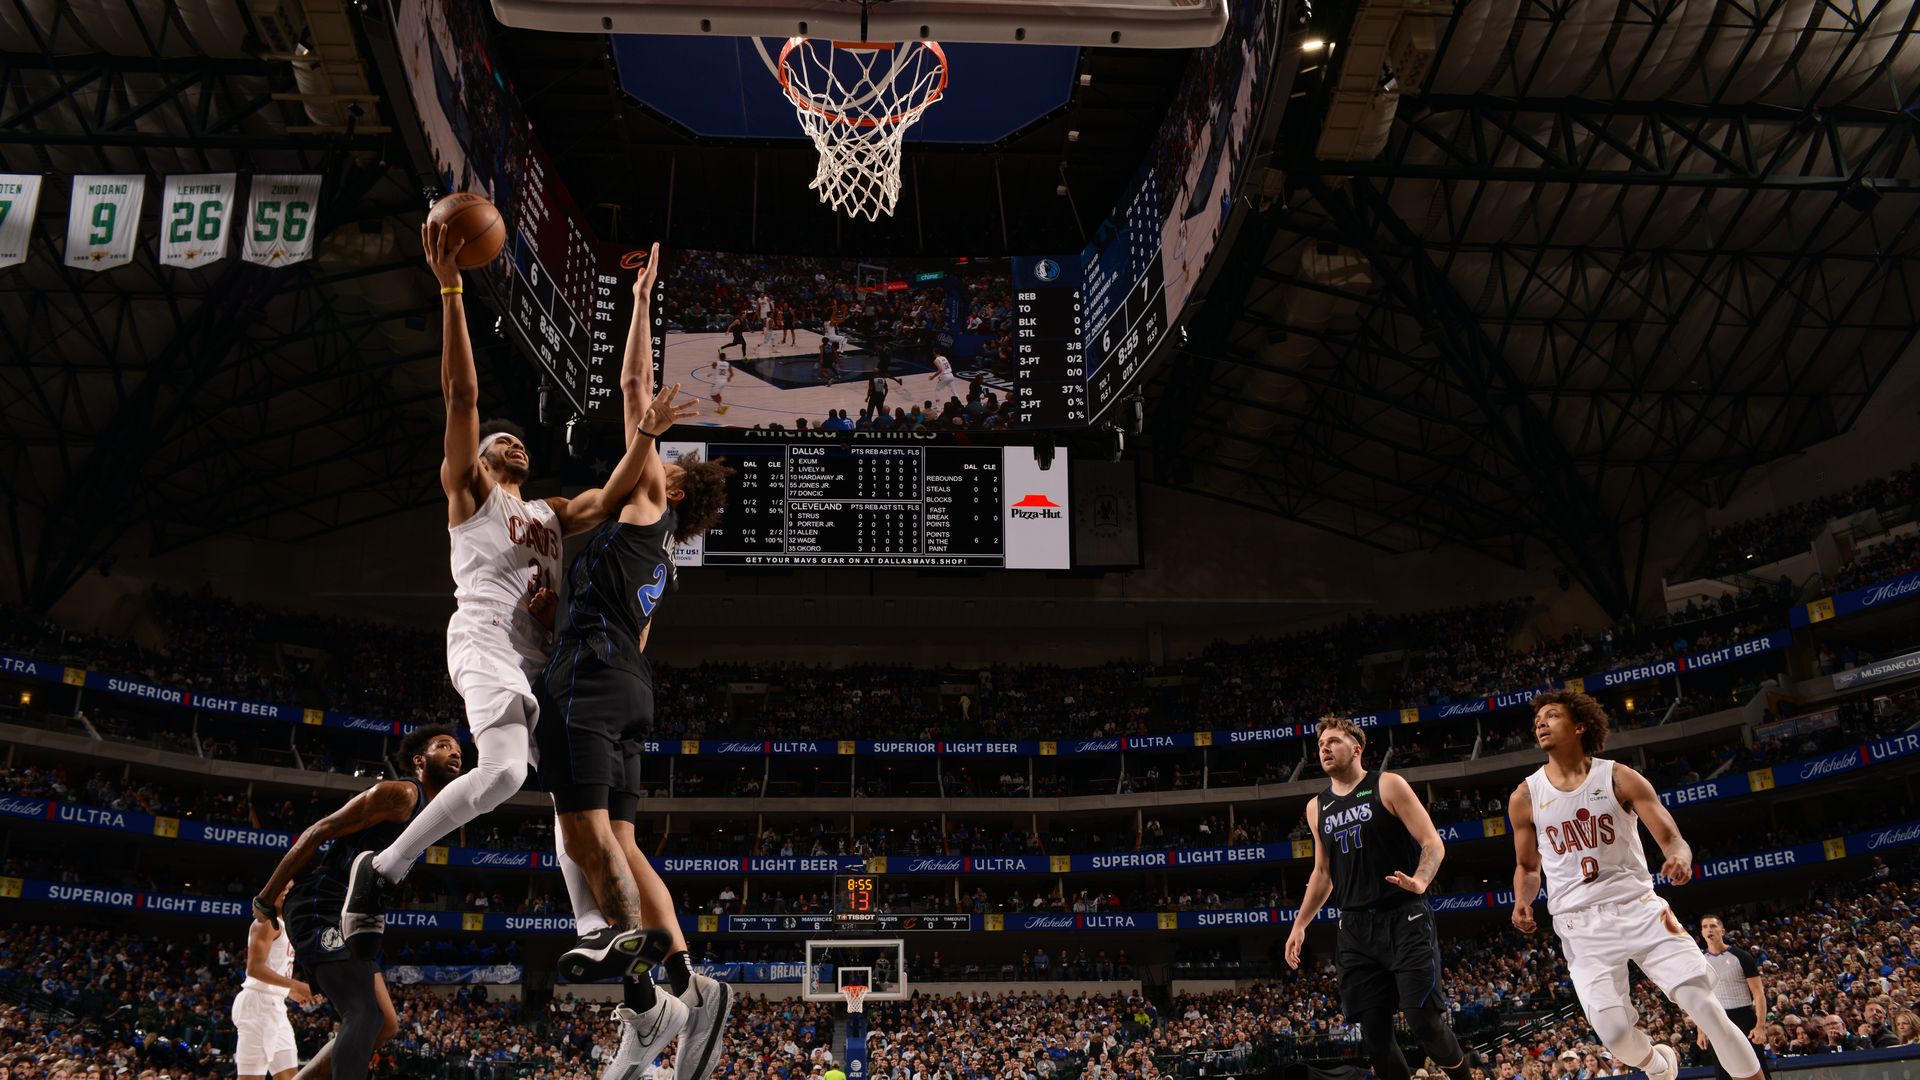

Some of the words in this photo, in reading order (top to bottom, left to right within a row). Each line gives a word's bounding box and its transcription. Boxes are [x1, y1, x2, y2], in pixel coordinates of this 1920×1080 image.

[88, 184, 127, 194] MODANO
[178, 184, 221, 195] LEHTINEN
[90, 202, 116, 246] 9
[170, 201, 222, 242] 26
[254, 202, 309, 242] 56
[531, 262, 538, 286] 6
[598, 275, 617, 285] REB
[597, 287, 611, 296] TO
[1139, 274, 1148, 302] 7
[1018, 292, 1036, 301] REB
[596, 300, 615, 310] BLK
[1018, 305, 1031, 313] TO
[595, 312, 612, 322] STL
[1018, 318, 1037, 326] BLK
[569, 313, 578, 338] 7
[539, 312, 563, 355] 8:55
[594, 331, 607, 340] FG
[1019, 329, 1035, 338] STL
[592, 343, 614, 353] 3-PT
[1019, 345, 1032, 353] FG
[1066, 342, 1082, 351] 3/8
[1103, 330, 1111, 352] 6
[1116, 327, 1139, 368] 8:55
[591, 356, 604, 365] FT
[1020, 356, 1040, 365] 3-PT
[1067, 354, 1083, 363] 0/2
[590, 374, 603, 384] FG
[1019, 370, 1031, 378] FT
[1067, 368, 1083, 377] 0/0
[589, 387, 612, 397] 3-PT
[1020, 387, 1033, 396] FG
[1062, 385, 1074, 394] 37
[588, 400, 601, 409] FT
[1020, 400, 1041, 409] 3-PT
[1021, 414, 1032, 422] FT
[792, 447, 825, 456] DALLAS
[509, 516, 558, 560] CAVS
[637, 563, 667, 616] 2
[1862, 576, 1920, 606] Michelo
[0, 656, 37, 676] TRA
[1604, 659, 1676, 686] SUPERIOR
[1688, 648, 1730, 670] LIGHT
[1734, 638, 1770, 657] BEER
[1861, 662, 1906, 678] MUSTANG
[108, 679, 181, 703] SUPERIOR
[193, 695, 238, 711] LIGHT
[241, 702, 278, 717] BEER
[1438, 700, 1485, 718] Michelob
[343, 717, 391, 731] Michelob
[1230, 727, 1293, 742] SUPERIOR
[717, 742, 762, 753] Michelob
[773, 742, 817, 752] ULTRA
[874, 742, 935, 753] SUPERIOR
[946, 743, 983, 753] LIGHT
[986, 743, 1017, 753] BEER
[1076, 740, 1118, 753] Michelob
[1130, 736, 1174, 748] ULTRA
[1800, 751, 1858, 780] Michelob
[1872, 734, 1920, 760] ULTR
[1676, 783, 1718, 803] BEER
[61, 806, 124, 827] ULTRA
[1324, 803, 1372, 834] MAVS
[203, 826, 288, 848] SUPERIOR
[1334, 824, 1362, 854] 77
[1546, 814, 1615, 855] CAVS
[471, 852, 529, 866] Michelob
[1092, 853, 1166, 868] SUPERIOR
[1178, 850, 1223, 864] LIGHT
[1228, 847, 1265, 861] BEER
[1703, 854, 1749, 877] LIGHT
[1754, 850, 1795, 869] BEER
[664, 859, 739, 871] SUPERIOR
[752, 859, 796, 871] LIGHT
[800, 859, 838, 871] BEER
[908, 859, 961, 872] Michelob
[974, 859, 1026, 870] ULTRA
[1581, 856, 1598, 883] 9
[848, 879, 872, 890] 8:55
[48, 885, 133, 906] SUPERIOR
[147, 896, 197, 912] LIGHT
[200, 901, 242, 915] BEER
[850, 892, 869, 910] 13
[1432, 895, 1483, 912] Michelob
[385, 913, 438, 926] ULTRA
[505, 916, 577, 930] SUPERIOR
[1024, 916, 1073, 929] Michelob
[1086, 916, 1135, 927] ULTRA
[1198, 911, 1268, 925] SUPERIOR
